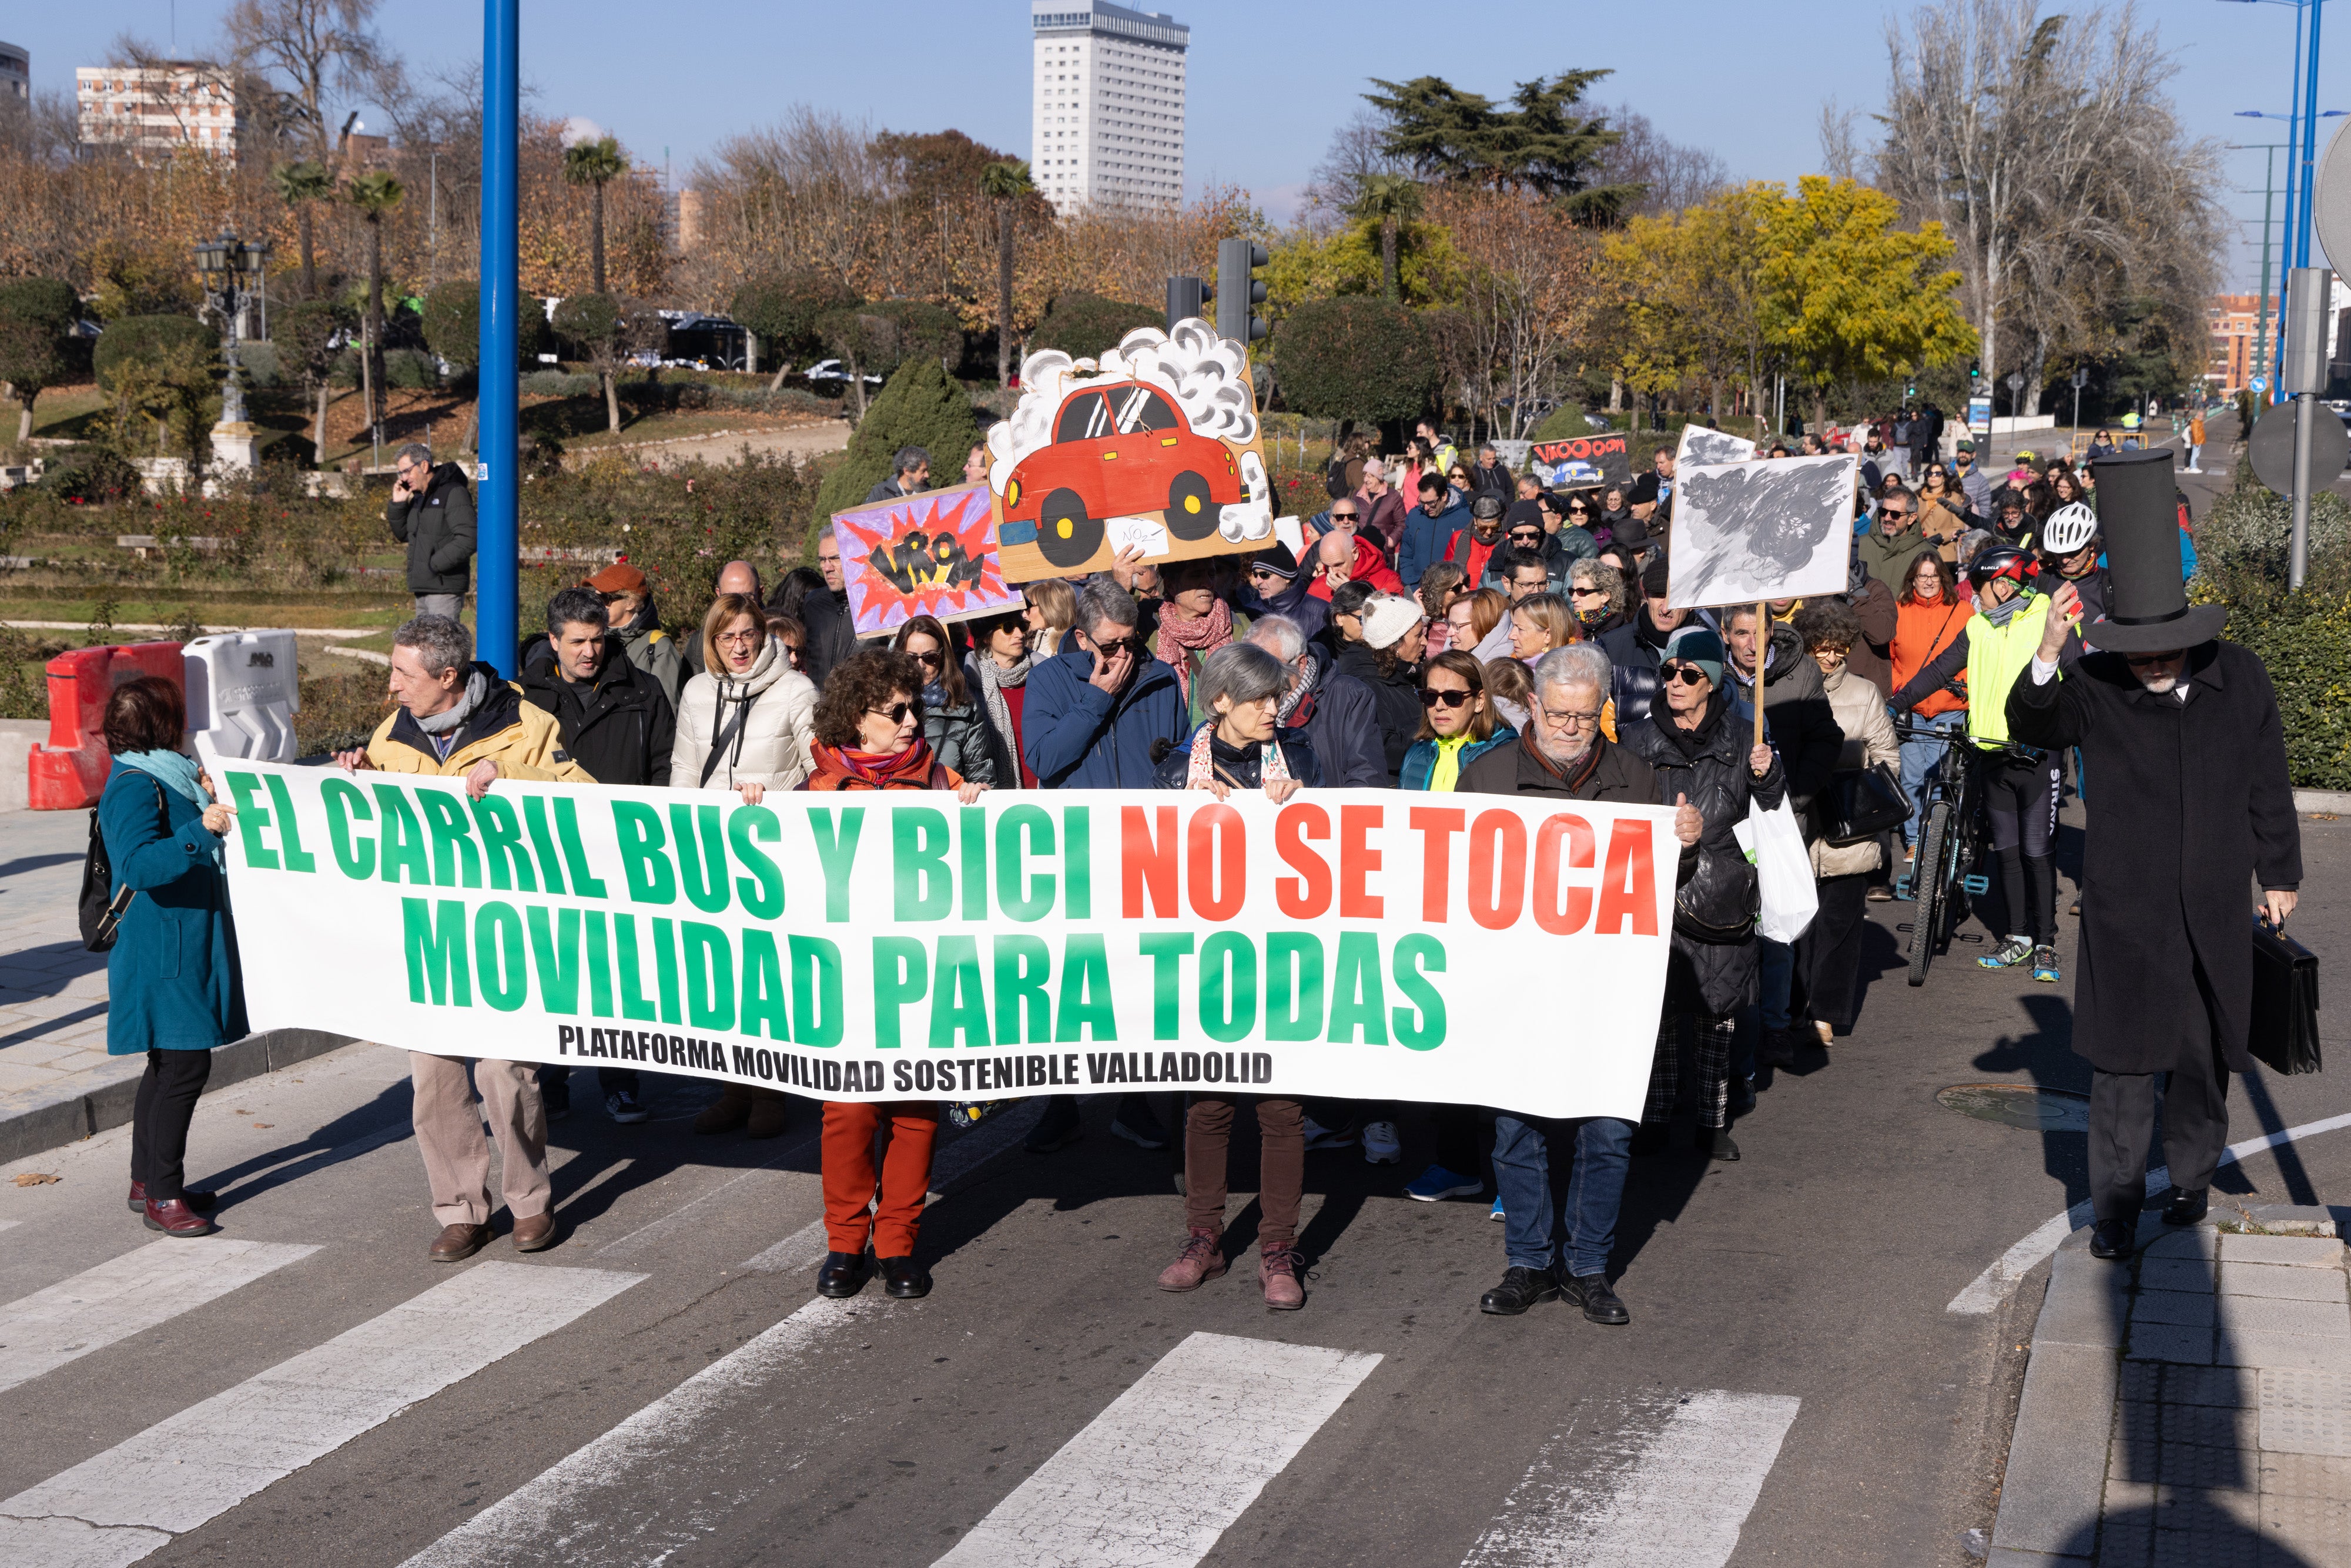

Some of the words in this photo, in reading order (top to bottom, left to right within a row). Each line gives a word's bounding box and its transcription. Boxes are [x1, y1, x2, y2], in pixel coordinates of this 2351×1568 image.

[225, 770, 316, 873] EL
[320, 778, 608, 899] CARRIL
[611, 800, 785, 920] BUS
[807, 807, 865, 922] Y
[892, 804, 1091, 922] BICI
[1121, 803, 1246, 922] NO
[1275, 803, 1384, 920] SE
[1410, 807, 1659, 936] TOCA
[2050, 769, 2060, 836] STRAVA
[401, 897, 843, 1048] MOVILIDAD
[873, 933, 1118, 1049] PARA
[1140, 930, 1447, 1051] TODAS
[559, 1025, 728, 1073] PLATAFORMA
[733, 1045, 885, 1092] MOVILIDAD
[893, 1054, 1079, 1092] SOSTENIBLE
[1086, 1051, 1272, 1084] VALLADOLID
